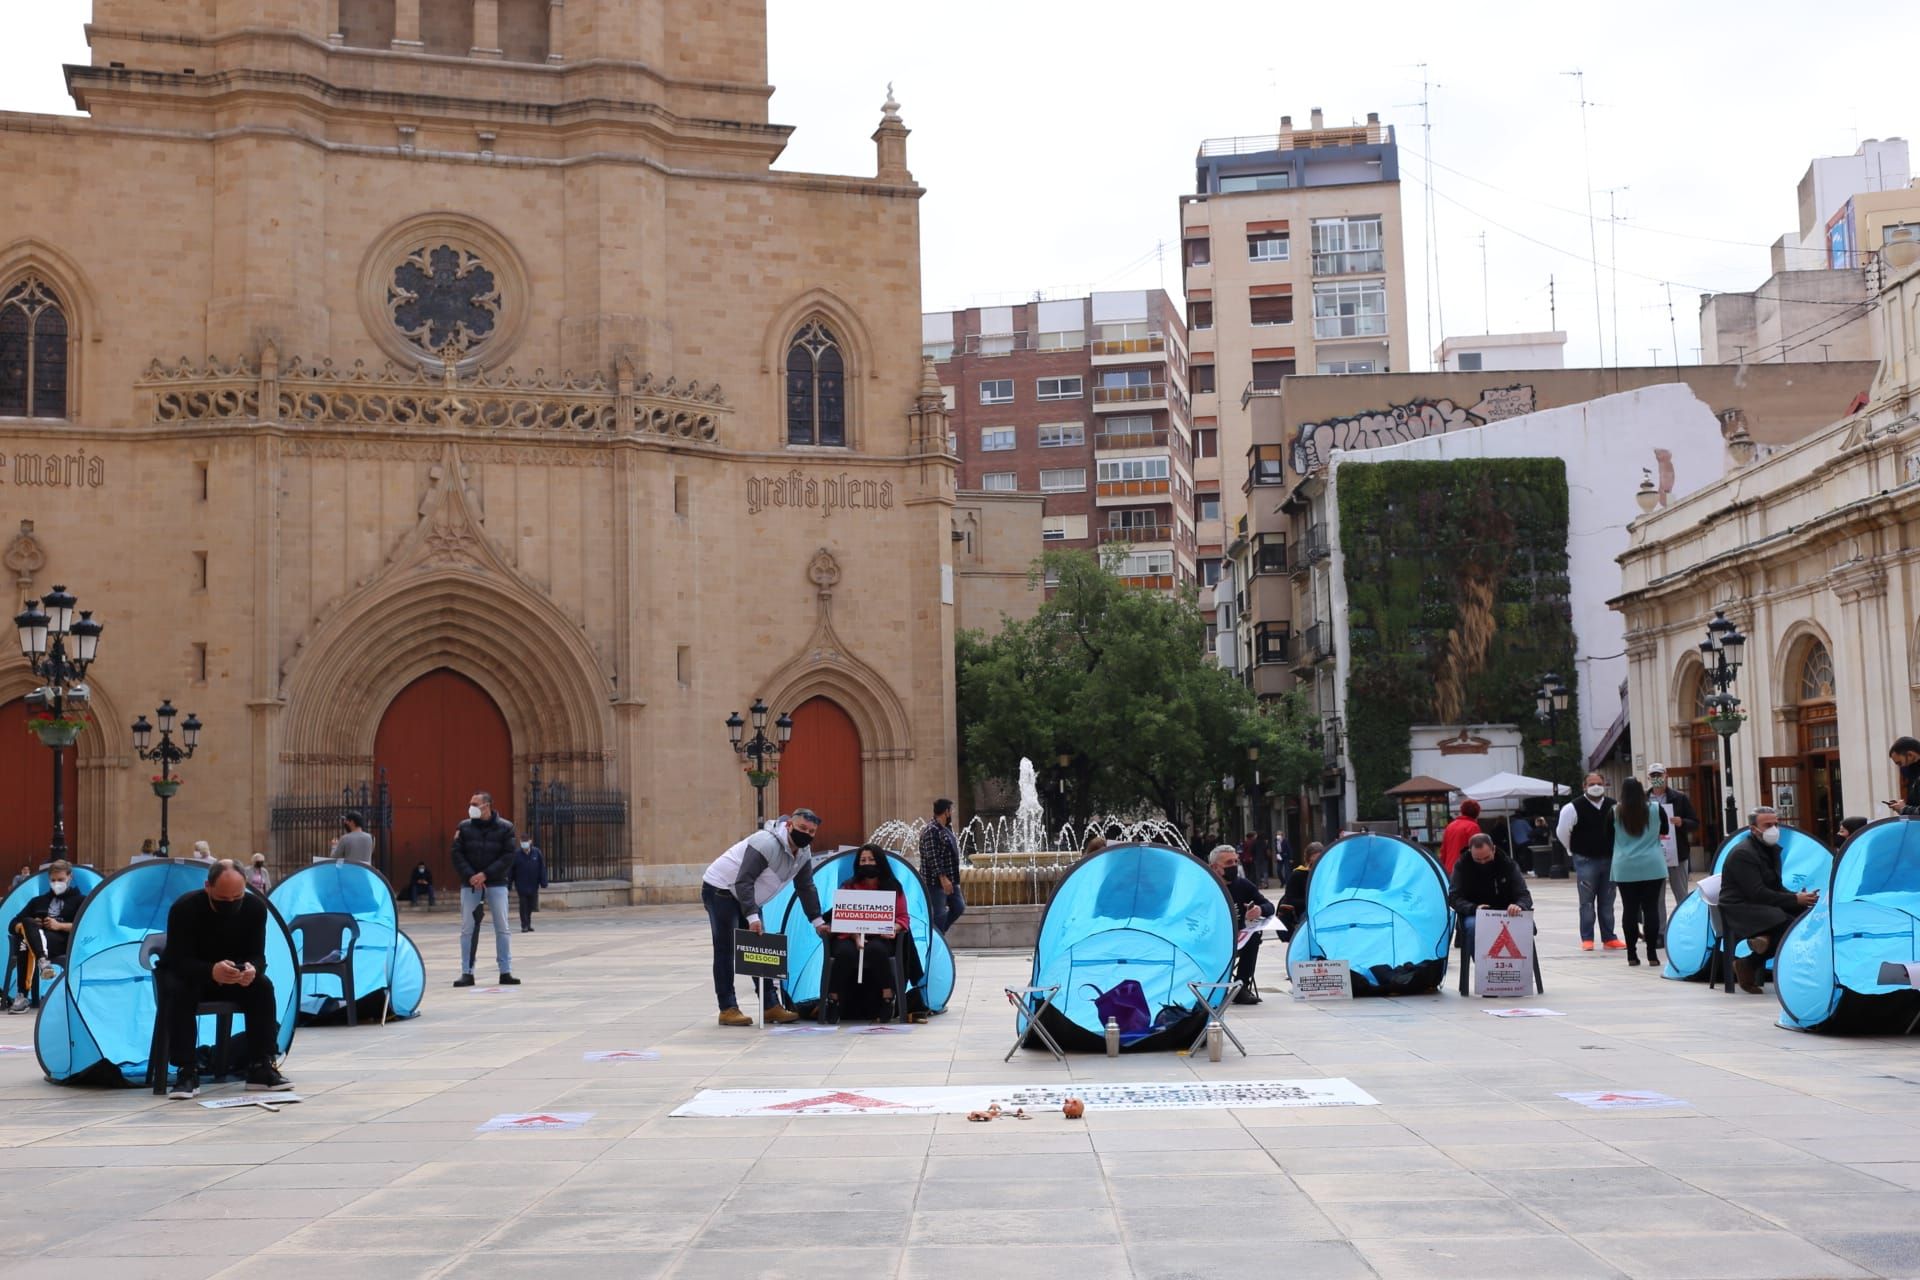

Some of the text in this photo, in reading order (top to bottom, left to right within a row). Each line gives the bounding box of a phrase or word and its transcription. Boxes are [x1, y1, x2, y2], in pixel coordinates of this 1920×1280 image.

[14, 448, 104, 488] maria
[822, 472, 894, 518] plena
[835, 903, 894, 911] NECESITAMOS
[736, 944, 787, 957] FIESTAS ILEGALES
